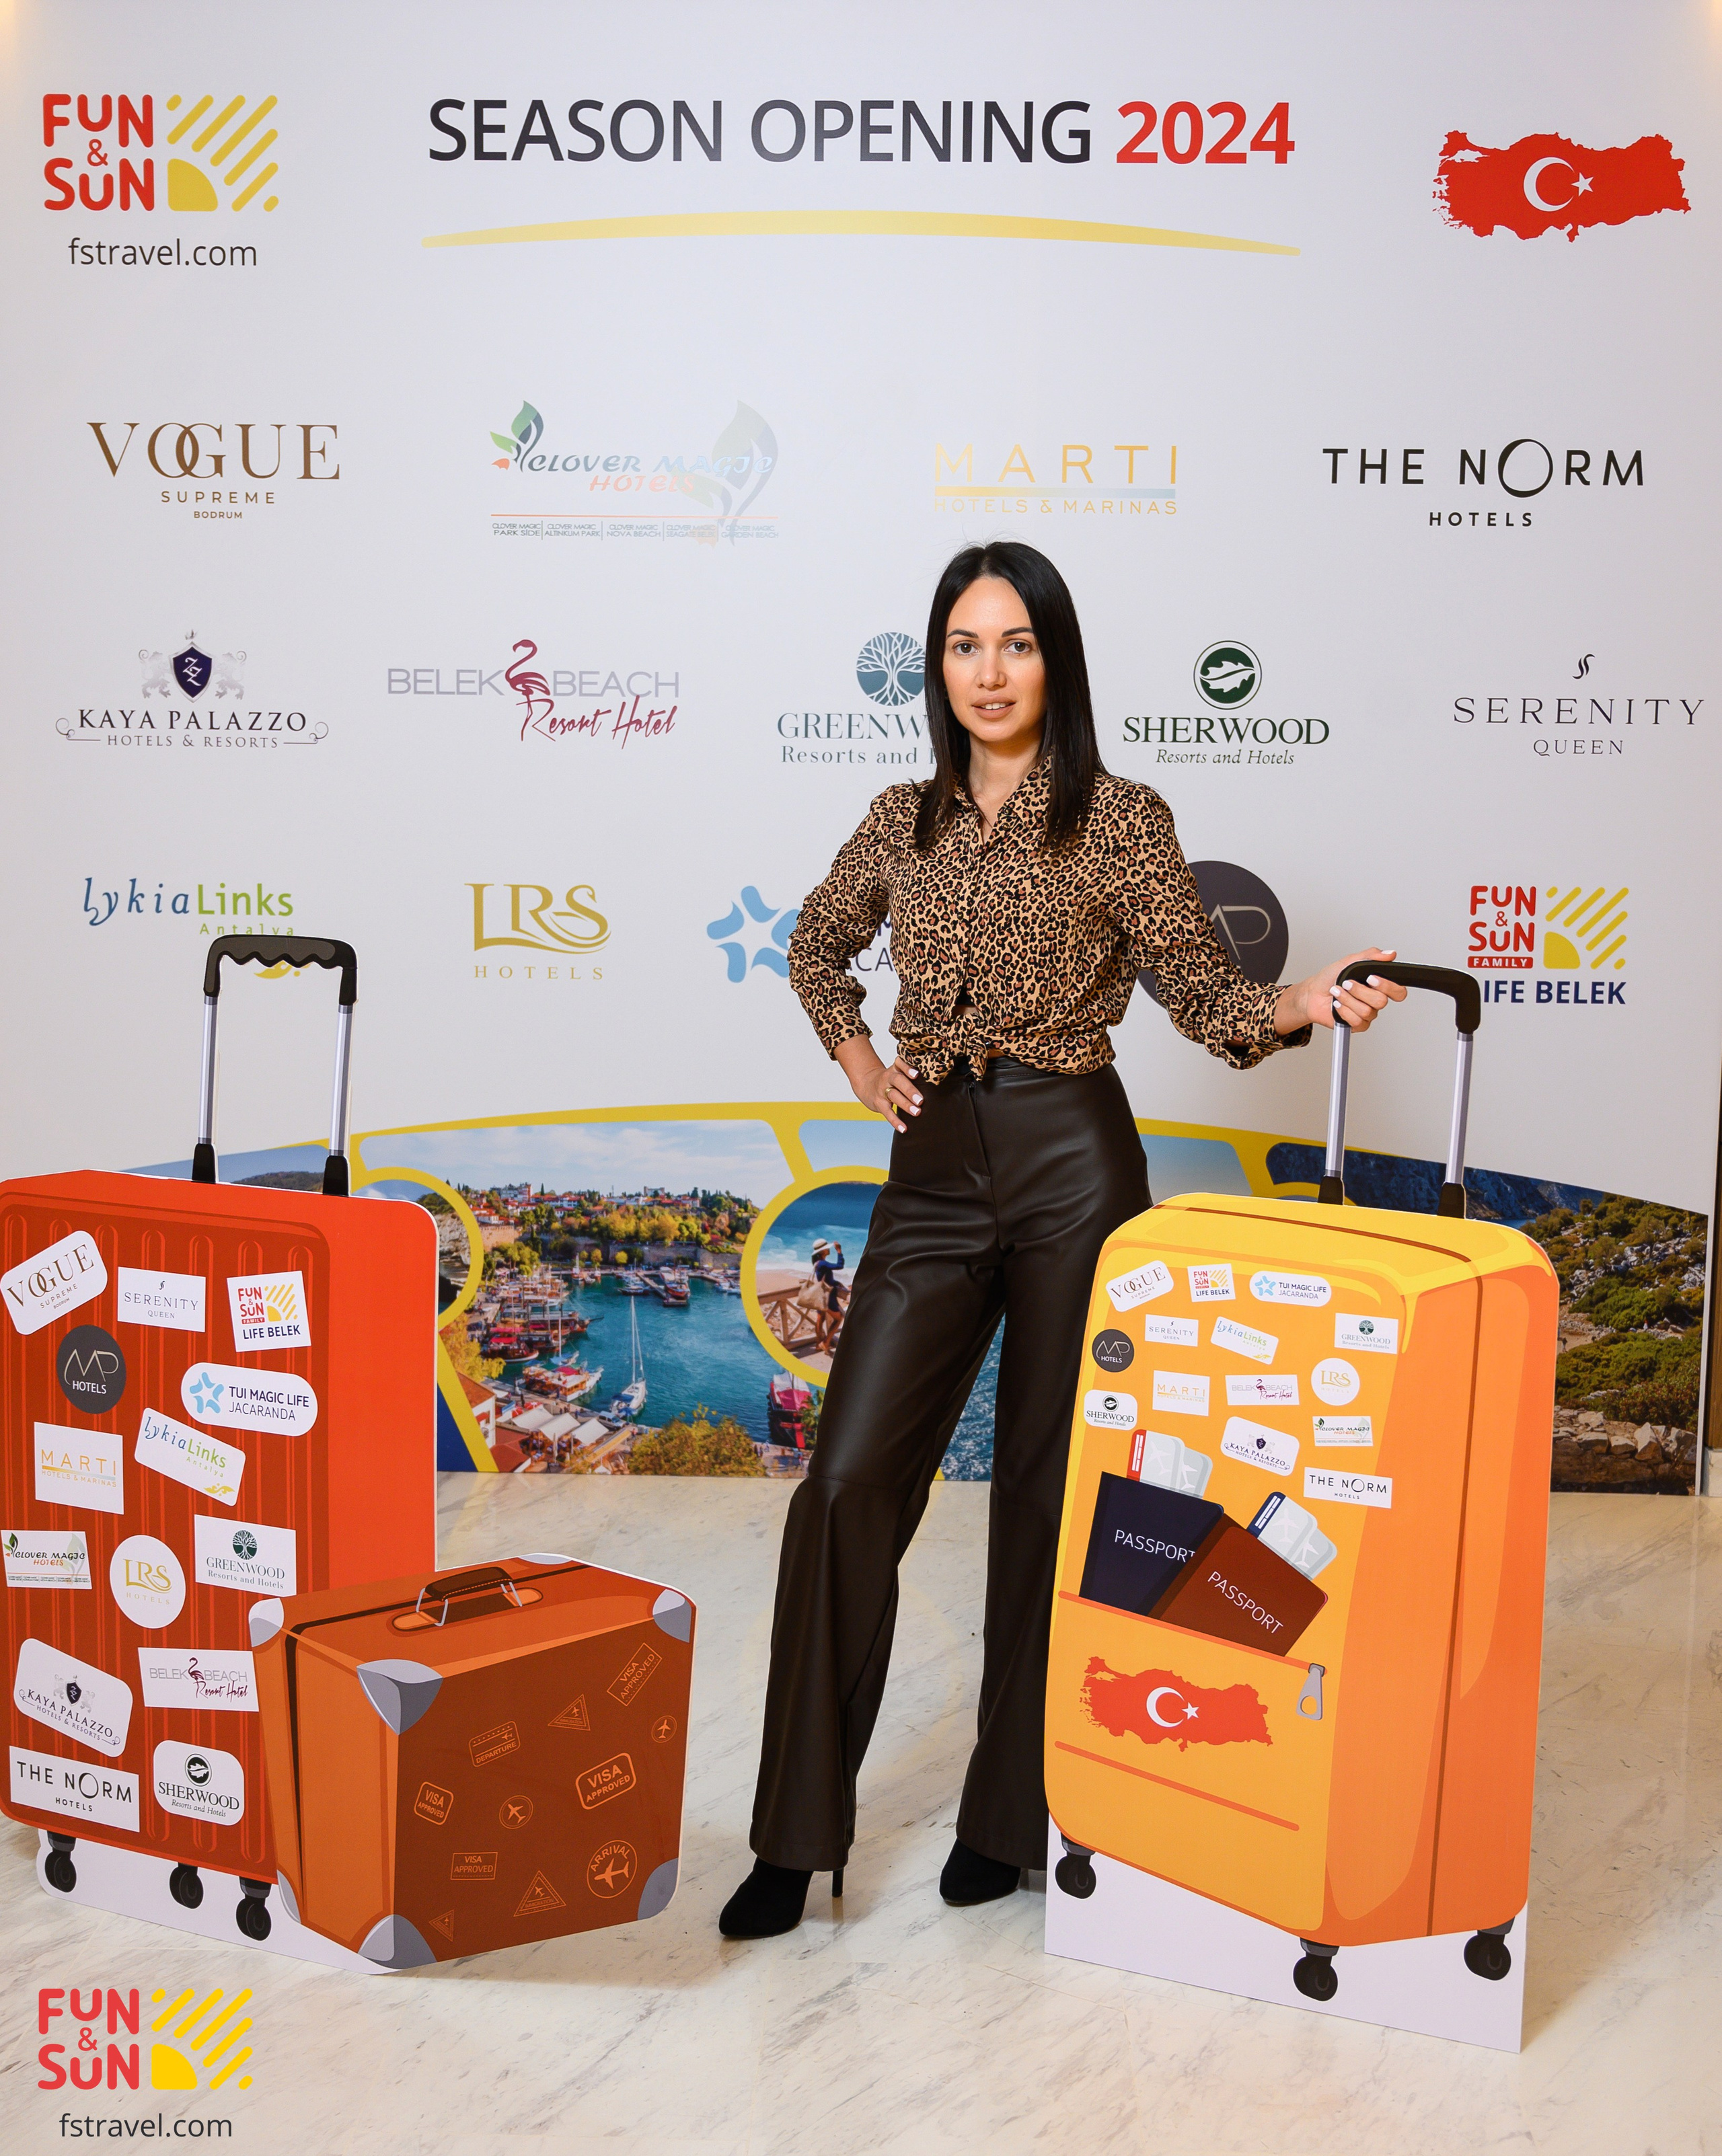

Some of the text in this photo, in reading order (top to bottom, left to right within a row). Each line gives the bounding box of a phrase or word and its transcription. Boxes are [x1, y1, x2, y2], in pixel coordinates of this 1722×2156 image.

[43, 94, 153, 147] FUN
[429, 99, 1296, 164] SEASON OPENING 2024
[87, 139, 108, 166] &
[44, 158, 155, 211] SUN
[69, 237, 257, 266] fstravel.com
[87, 423, 340, 479] VOGUE
[528, 455, 774, 477] CLOVER MAGIC
[935, 445, 1176, 485] MARTI
[1322, 438, 1644, 498] THE NORM
[590, 475, 695, 492] HOTELS
[161, 491, 276, 504] SUPREME
[934, 499, 1176, 515] HOTELS & MARINAS
[194, 511, 243, 519] BODRUM
[1429, 512, 1532, 527] HOTELS
[388, 668, 679, 698] BELEK BEACH
[78, 709, 306, 732] KAYA PALAZZO
[1454, 696, 1704, 726] SERENITY
[516, 694, 678, 750] Resort Hotel
[778, 713, 928, 740] GREENW
[1123, 716, 1329, 745] SHERWOOD
[107, 735, 278, 748] HOTELS & RESORTS
[1533, 738, 1624, 757] QUEEN
[782, 746, 866, 763] Resorts
[877, 748, 917, 764] and
[1156, 749, 1294, 766] Resorts and Hotels
[1470, 886, 1536, 917] FUN
[465, 883, 612, 954] LRS
[1496, 912, 1507, 927] &
[1468, 922, 1535, 952] SUN
[475, 966, 603, 980] HOTELS
[1474, 958, 1527, 967] FAMILY
[1484, 980, 1626, 1004] IFE BELEK
[7, 1244, 94, 1307] VOGUE
[1111, 1267, 1166, 1298] VOGUE
[40, 1284, 78, 1308] SUPREME
[54, 1298, 70, 1309] BODRUM
[124, 1292, 198, 1311] SERENITY
[238, 1286, 262, 1301] FUN
[1279, 1290, 1318, 1299] JACARANDA
[148, 1310, 175, 1319] QUEEN
[240, 1303, 264, 1317] SUN
[243, 1325, 301, 1339] LIFE BELEK
[1149, 1326, 1193, 1336] SERENITY
[1341, 1334, 1390, 1344] GREENWOOD
[72, 1381, 106, 1394] HOTELS
[1321, 1371, 1351, 1387] LRS
[229, 1387, 309, 1407] TUI MAGIC LIFE
[1158, 1384, 1205, 1397] MARTI
[229, 1402, 296, 1421] JACARANDA
[1086, 1410, 1134, 1422] SHERWOOD
[42, 1449, 116, 1475] MARTI
[1230, 1442, 1285, 1466] KAYA PALAZZO
[186, 1457, 224, 1478] Antalya
[42, 1470, 71, 1480] HOTELS
[81, 1476, 116, 1488] MARINAS
[1310, 1475, 1386, 1493] THE NORM
[1115, 1530, 1196, 1562] PASSPORT
[123, 1559, 172, 1593] LRS
[207, 1556, 285, 1579] GREENWOOD
[208, 1570, 284, 1590] Resorts and Hotels
[126, 1592, 170, 1605] HOTELS
[1207, 1571, 1283, 1633] PASSPORT
[150, 1668, 248, 1682] BELEK BEACH
[620, 1661, 638, 1683] VISA
[621, 1654, 654, 1699] APPROVED
[28, 1689, 113, 1738] KAYA PALAZZO
[37, 1705, 62, 1722] HOTELS
[72, 1722, 100, 1740] RESORTS
[476, 1740, 517, 1764] DEPARTURE
[17, 1761, 131, 1803] THE NORM
[587, 1764, 622, 1788] VISA
[159, 1781, 239, 1810] SHERWOOD
[425, 1790, 444, 1808] VISA
[587, 1775, 630, 1802] APPROVED
[56, 1797, 93, 1812] HOTELS
[172, 1799, 226, 1817] Resorts and Hotels
[418, 1802, 444, 1818] APPROVED
[591, 1845, 630, 1872] ARRIVAL
[455, 1865, 493, 1874] APPROVED
